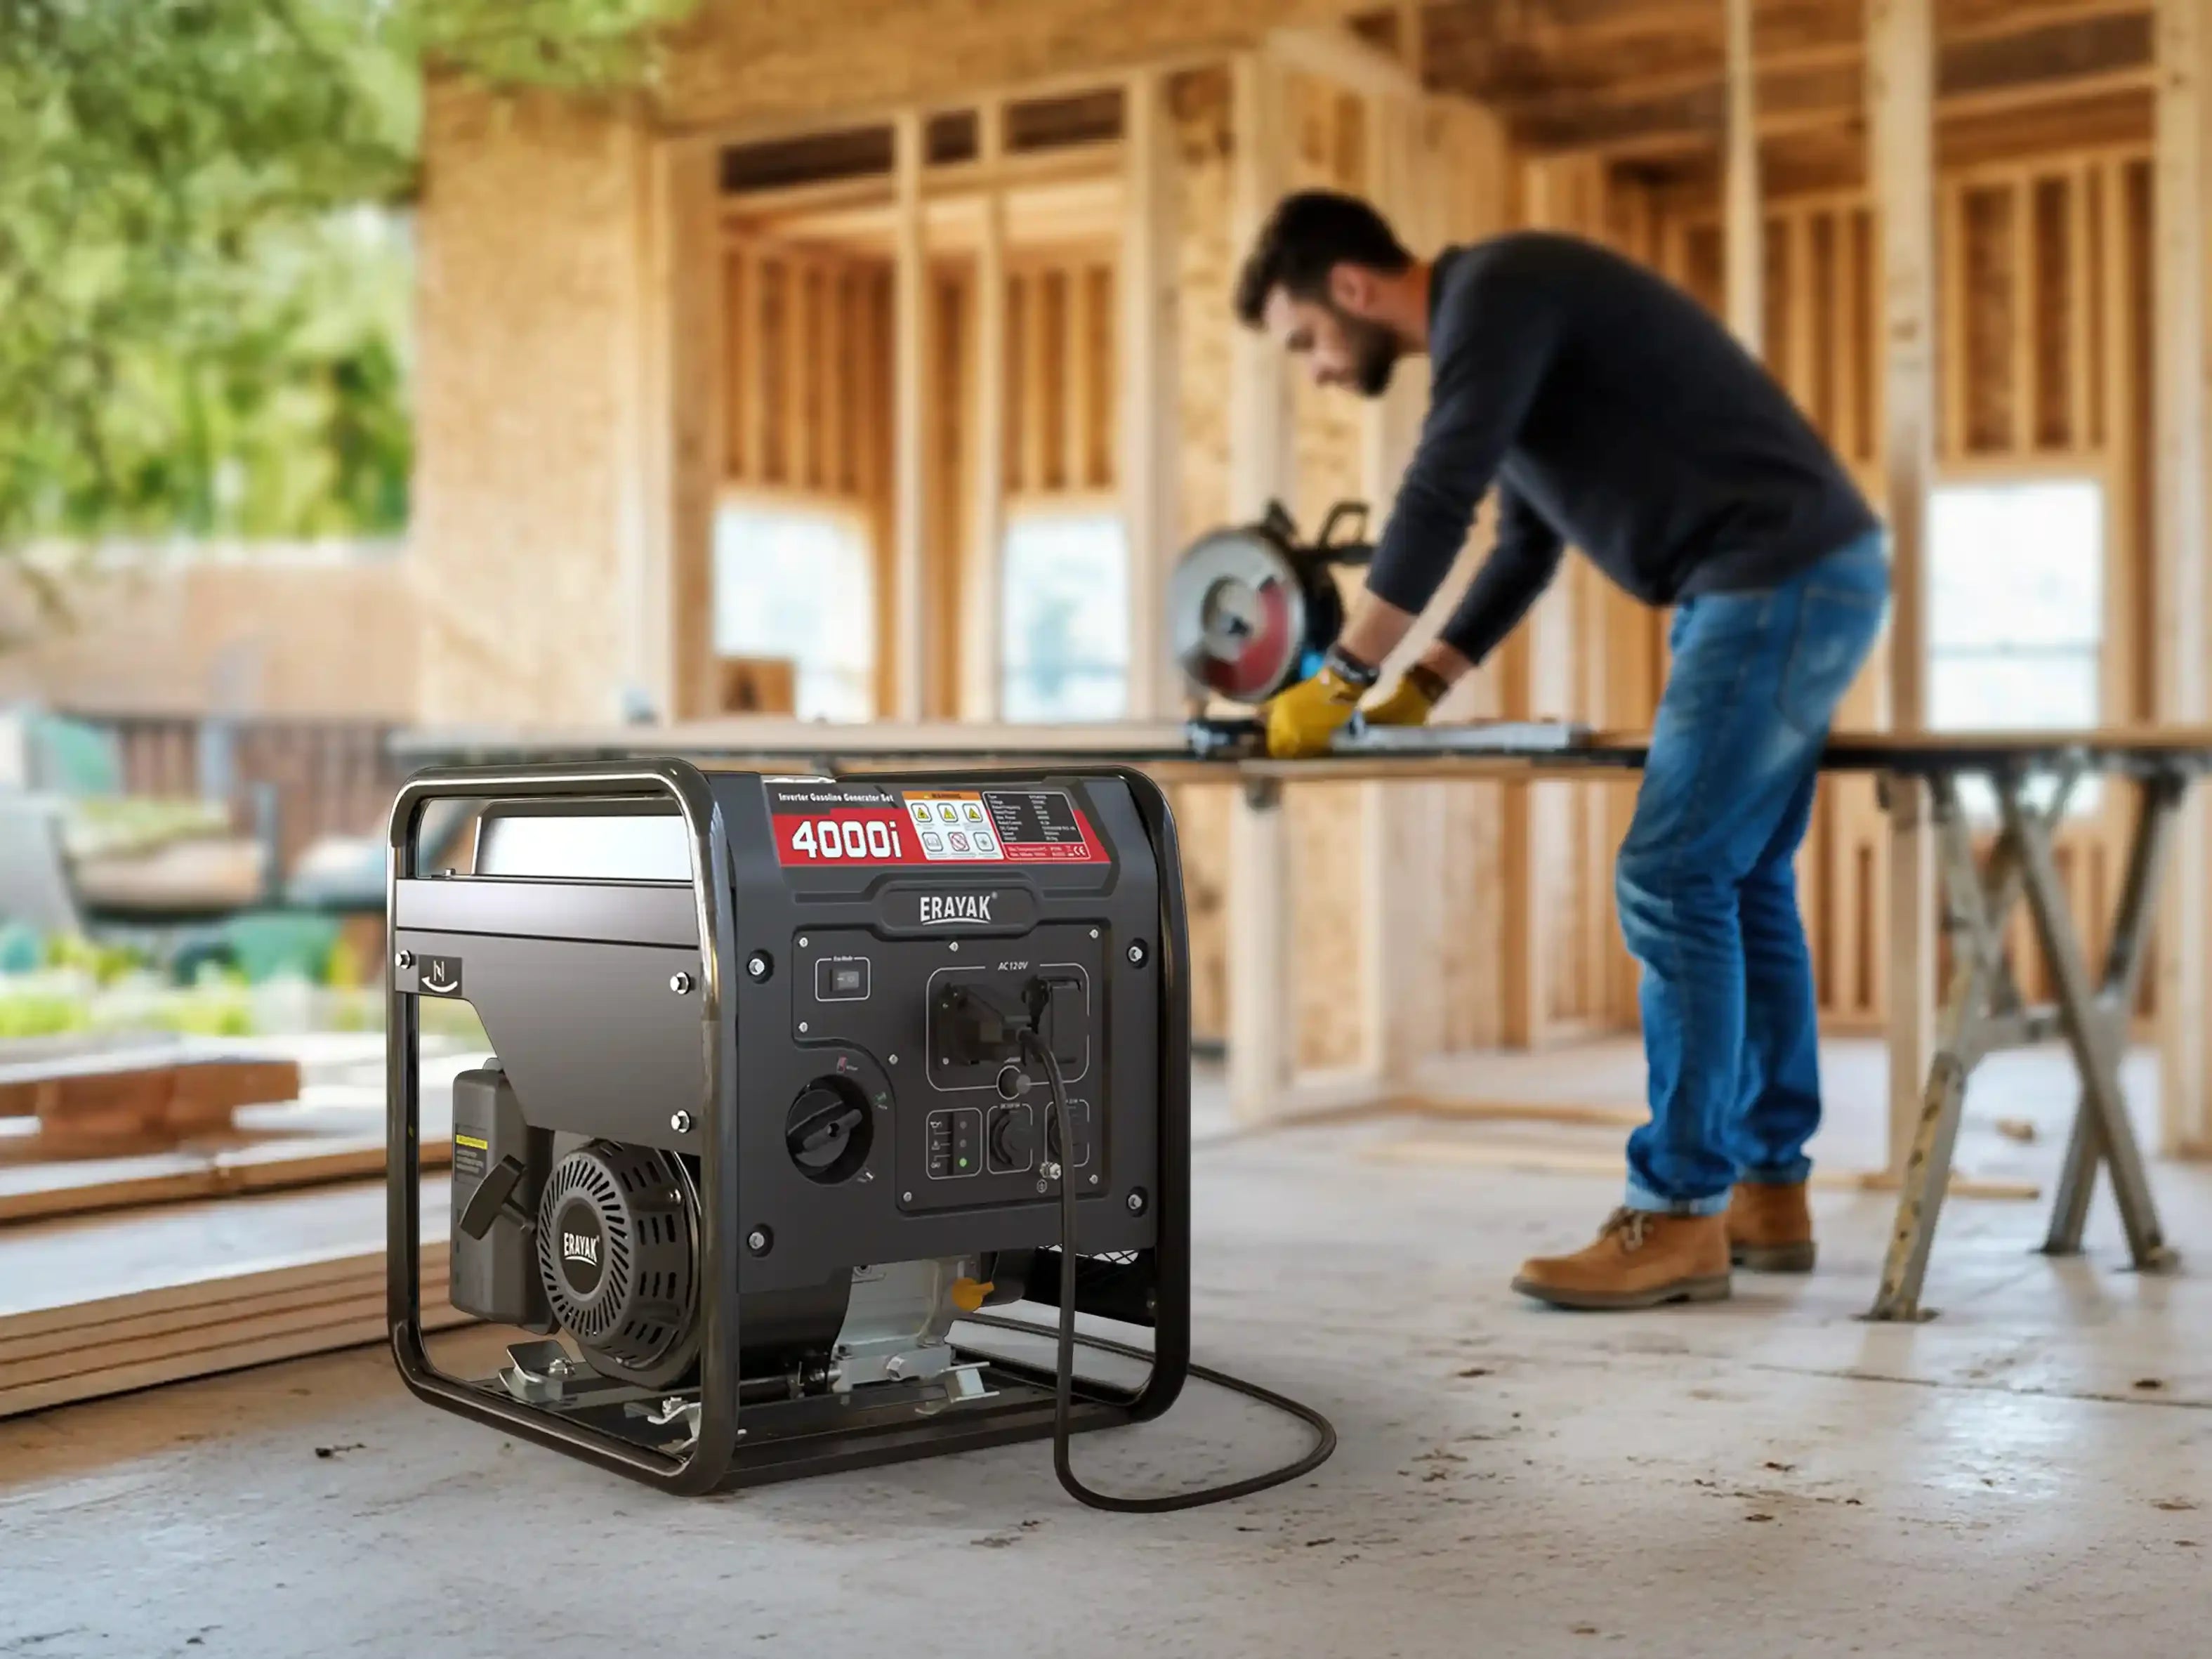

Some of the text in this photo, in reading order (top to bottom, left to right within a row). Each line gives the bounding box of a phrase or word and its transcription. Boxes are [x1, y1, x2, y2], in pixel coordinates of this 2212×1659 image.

[778, 793, 894, 802] Inverter Gasoline Generator Set
[792, 820, 902, 858] 4000i
[920, 896, 991, 922] ERAYAK
[564, 1232, 597, 1263] ERAYAK
